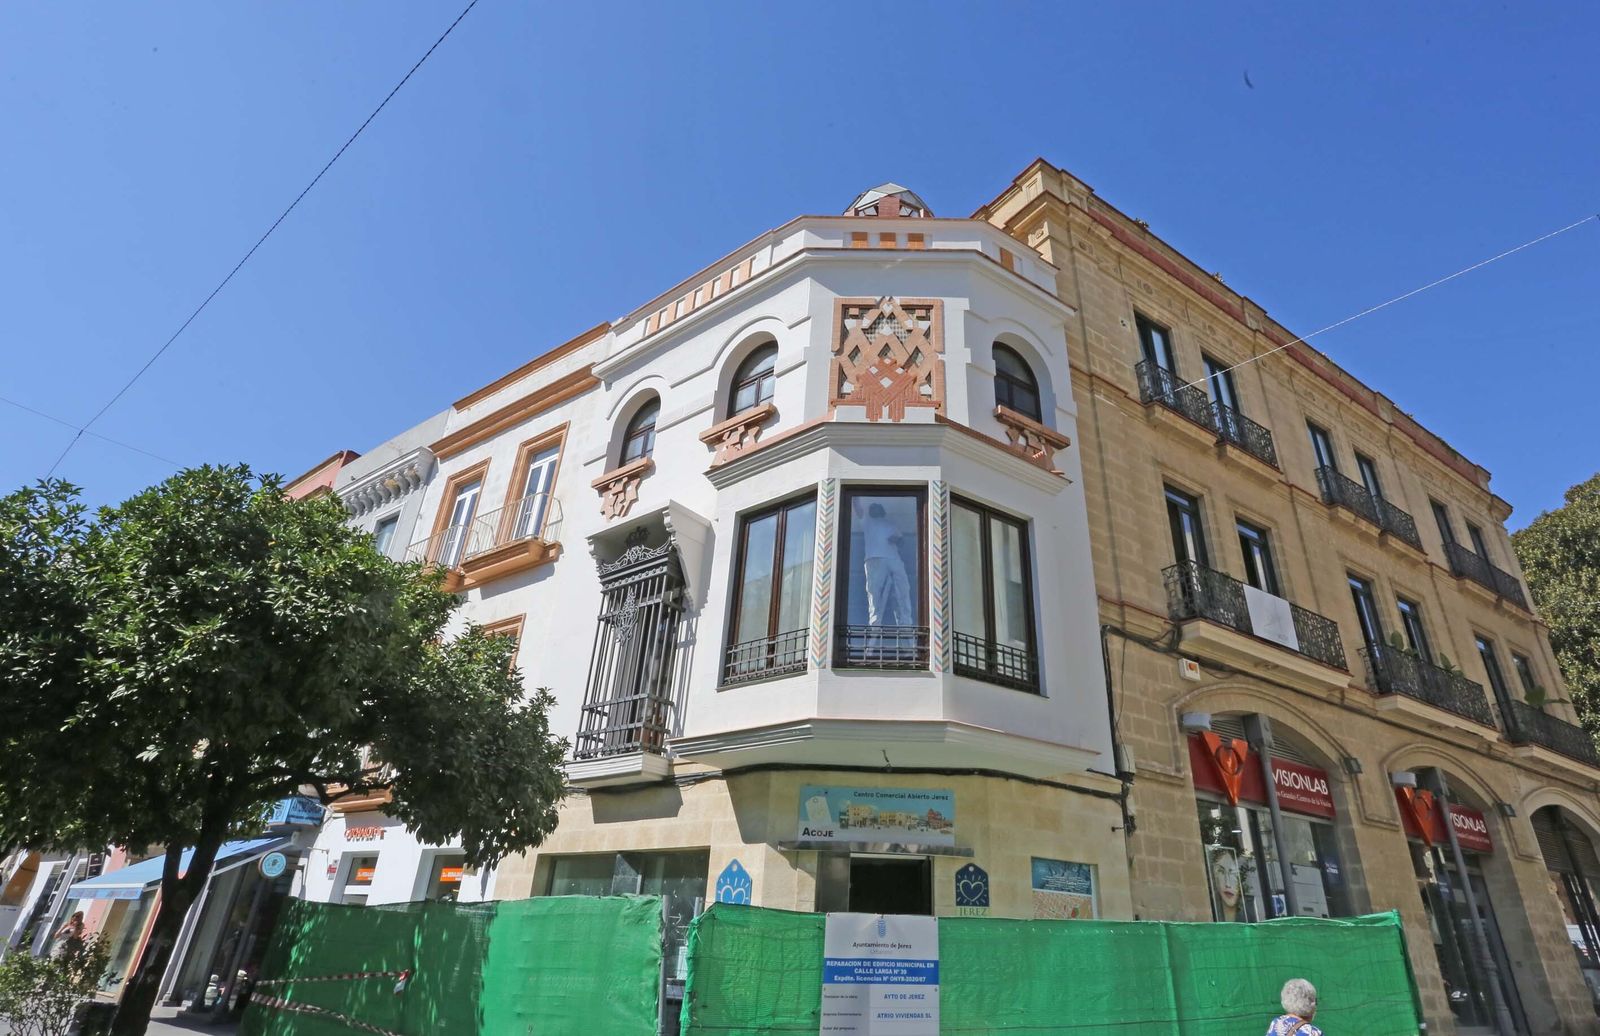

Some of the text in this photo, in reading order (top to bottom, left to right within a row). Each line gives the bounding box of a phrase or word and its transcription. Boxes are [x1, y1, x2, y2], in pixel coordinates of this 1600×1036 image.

[1271, 768, 1329, 795] VISIONLAB
[875, 791, 906, 799] Comercial
[907, 792, 930, 800] Abierto
[931, 793, 949, 801] Jerez
[802, 827, 834, 838] ACOJE
